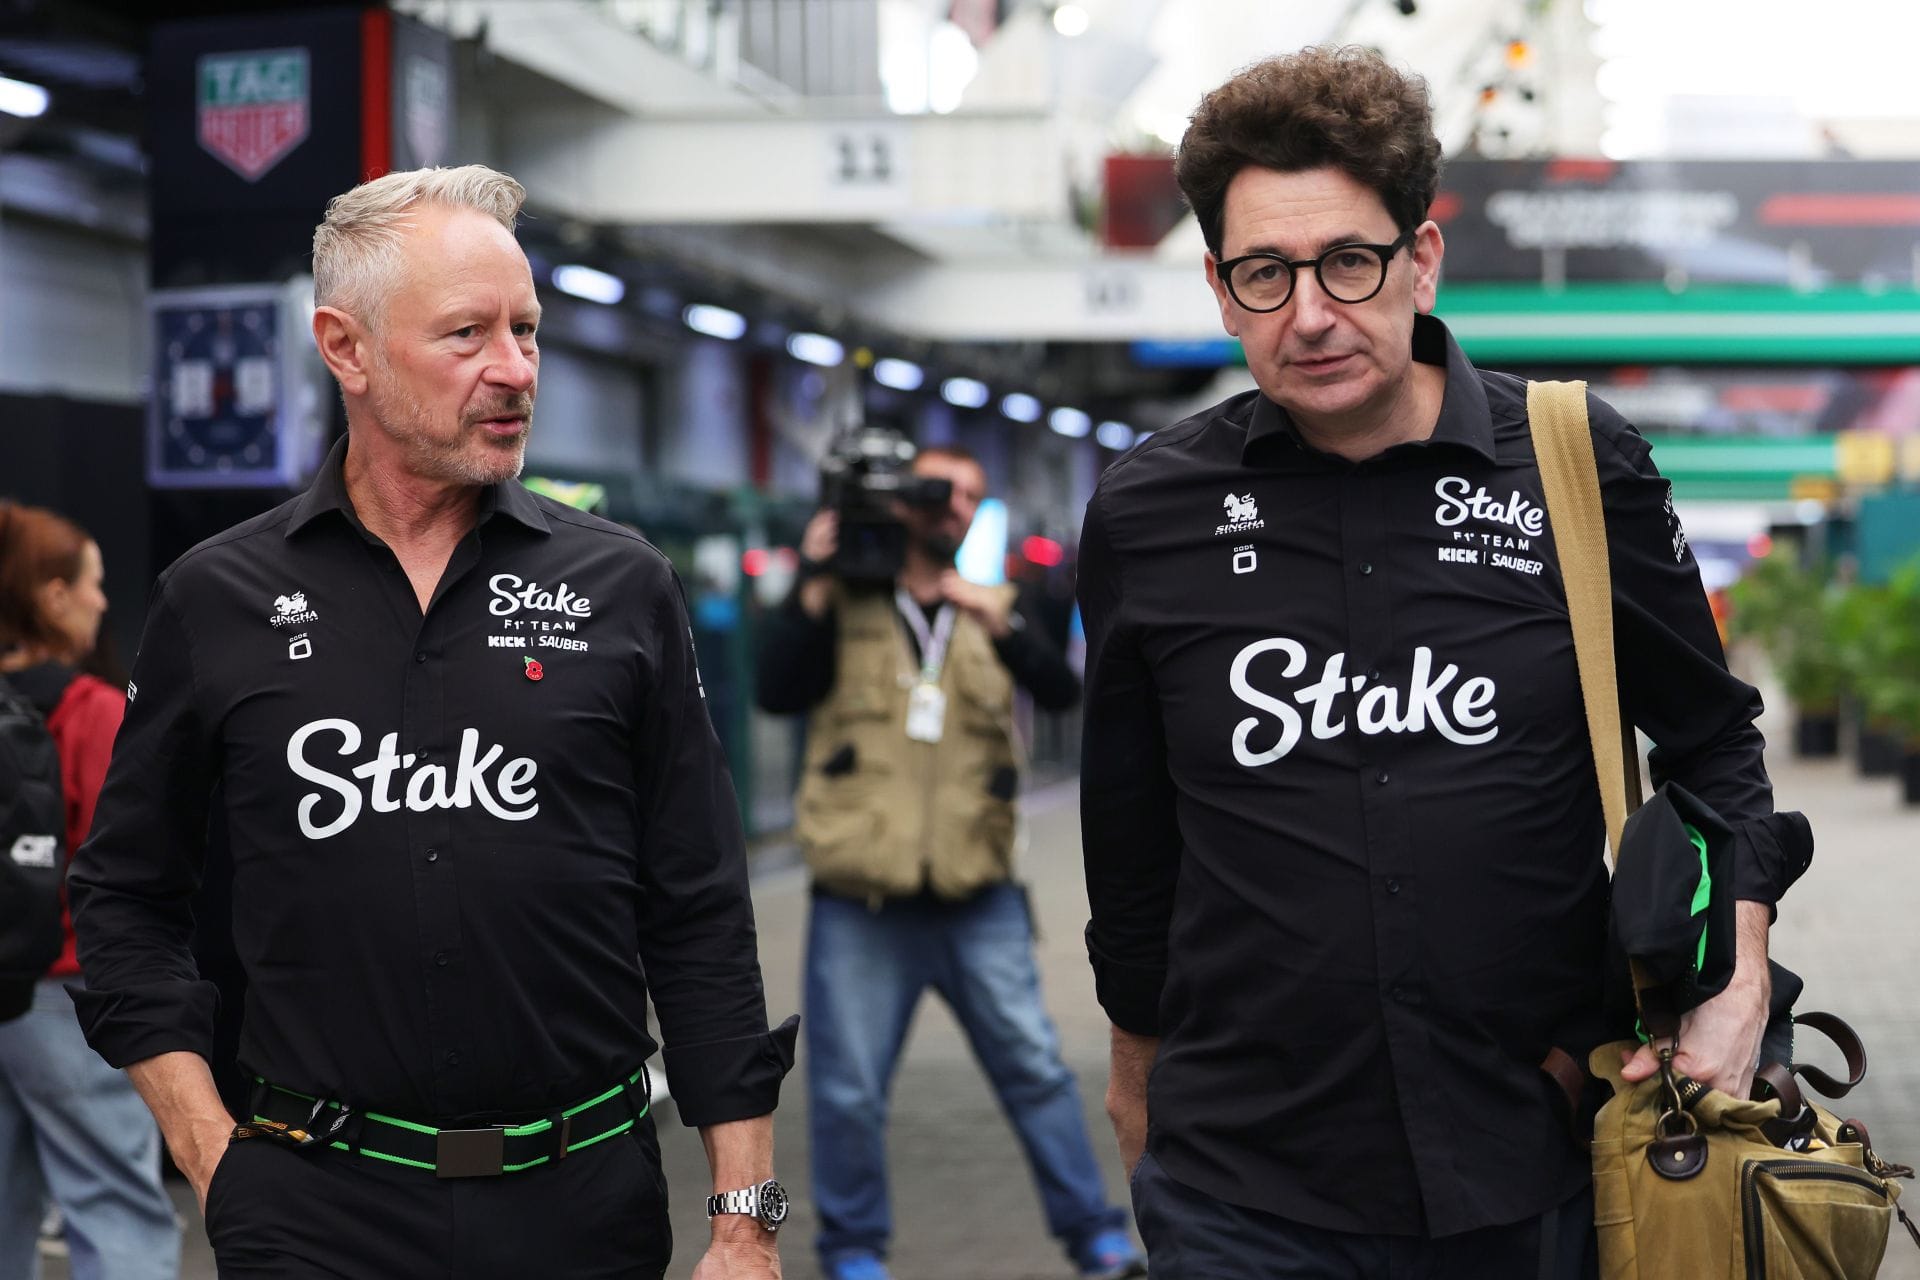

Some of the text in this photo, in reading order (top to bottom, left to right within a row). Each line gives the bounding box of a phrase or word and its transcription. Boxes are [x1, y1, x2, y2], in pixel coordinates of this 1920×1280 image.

[1435, 476, 1544, 536] Stake
[1216, 519, 1265, 534] SINGHA
[1481, 534, 1530, 551] TEAM
[1438, 547, 1544, 575] KICK SAUBER
[489, 573, 592, 617] Stake
[269, 610, 319, 626] SINGHA
[530, 621, 576, 631] TEAM
[487, 635, 589, 652] KICK SAUBER
[1229, 637, 1499, 767] Stake
[286, 718, 540, 840] Stake
